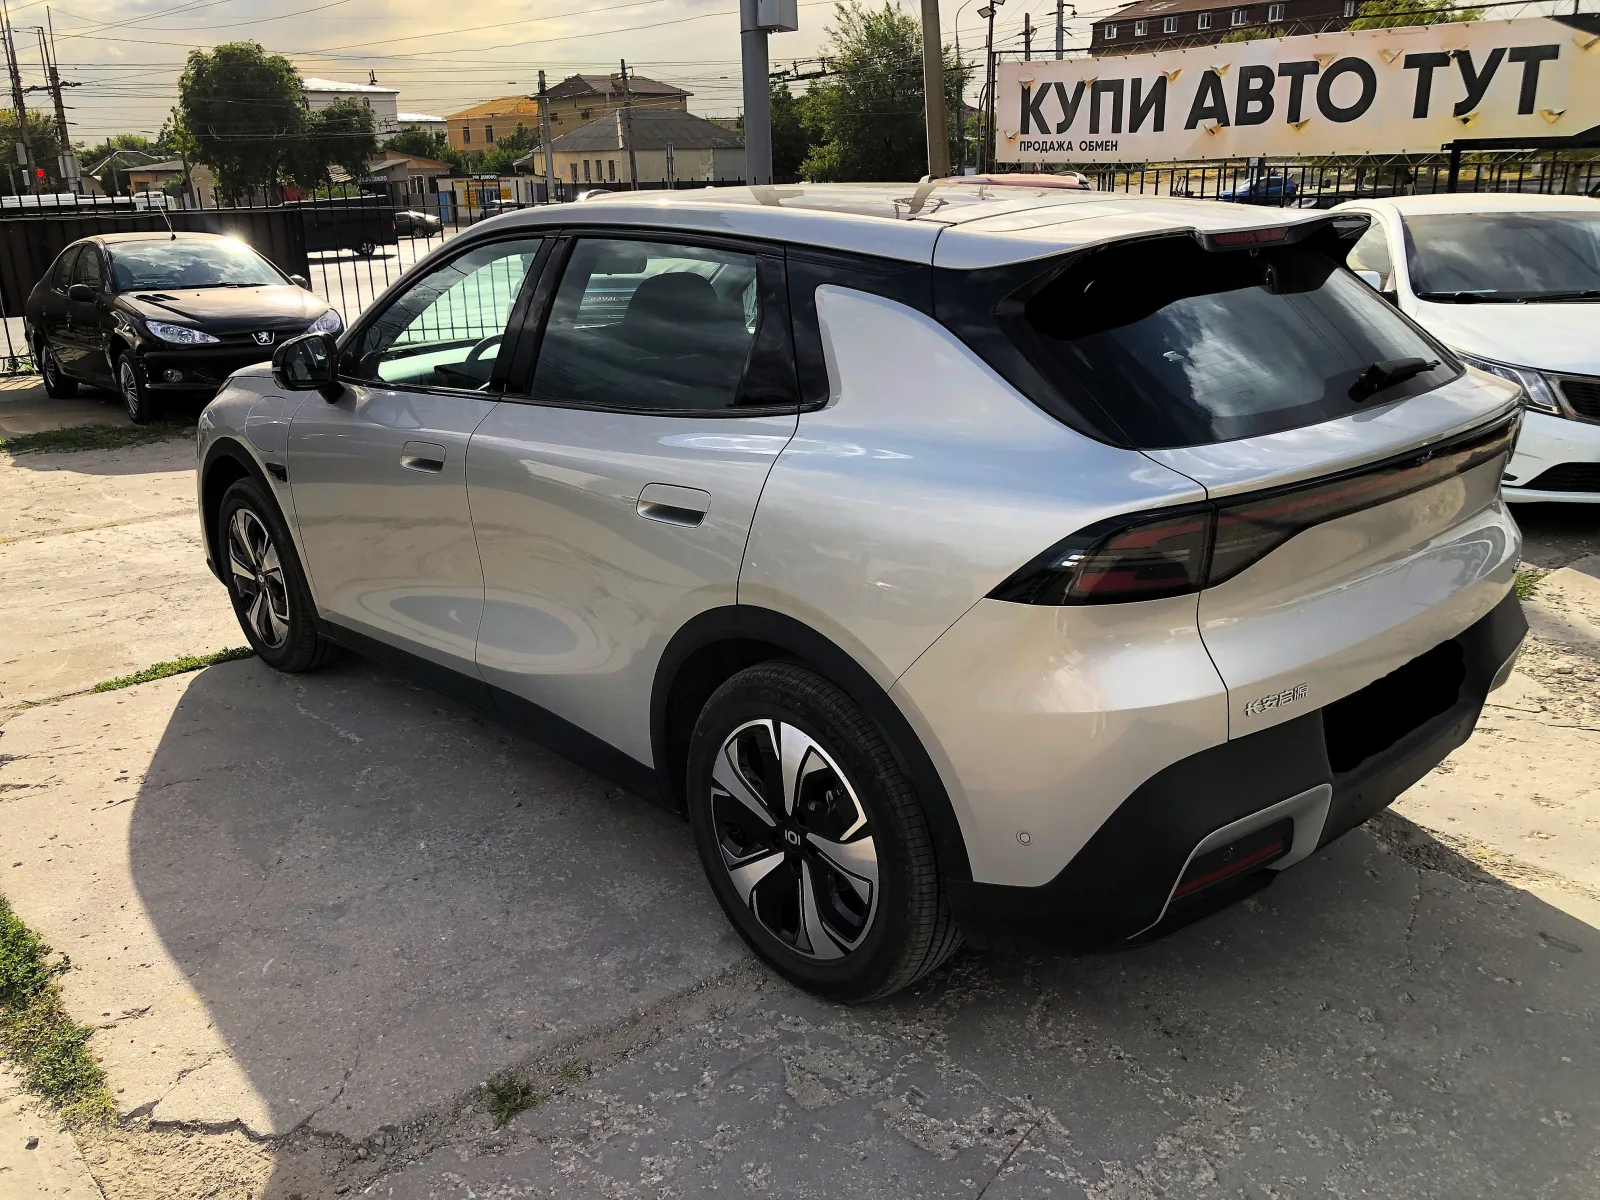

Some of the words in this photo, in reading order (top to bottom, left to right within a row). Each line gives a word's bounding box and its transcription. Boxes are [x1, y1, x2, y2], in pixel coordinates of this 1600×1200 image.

[1020, 76, 1168, 135] КУПИ
[1184, 56, 1377, 130] АВТО
[1403, 44, 1560, 119] ТУТ
[1019, 140, 1073, 153] ПРОДАЖА
[1079, 140, 1118, 152] ОБМЕН
[1243, 682, 1308, 717] 长安启源
